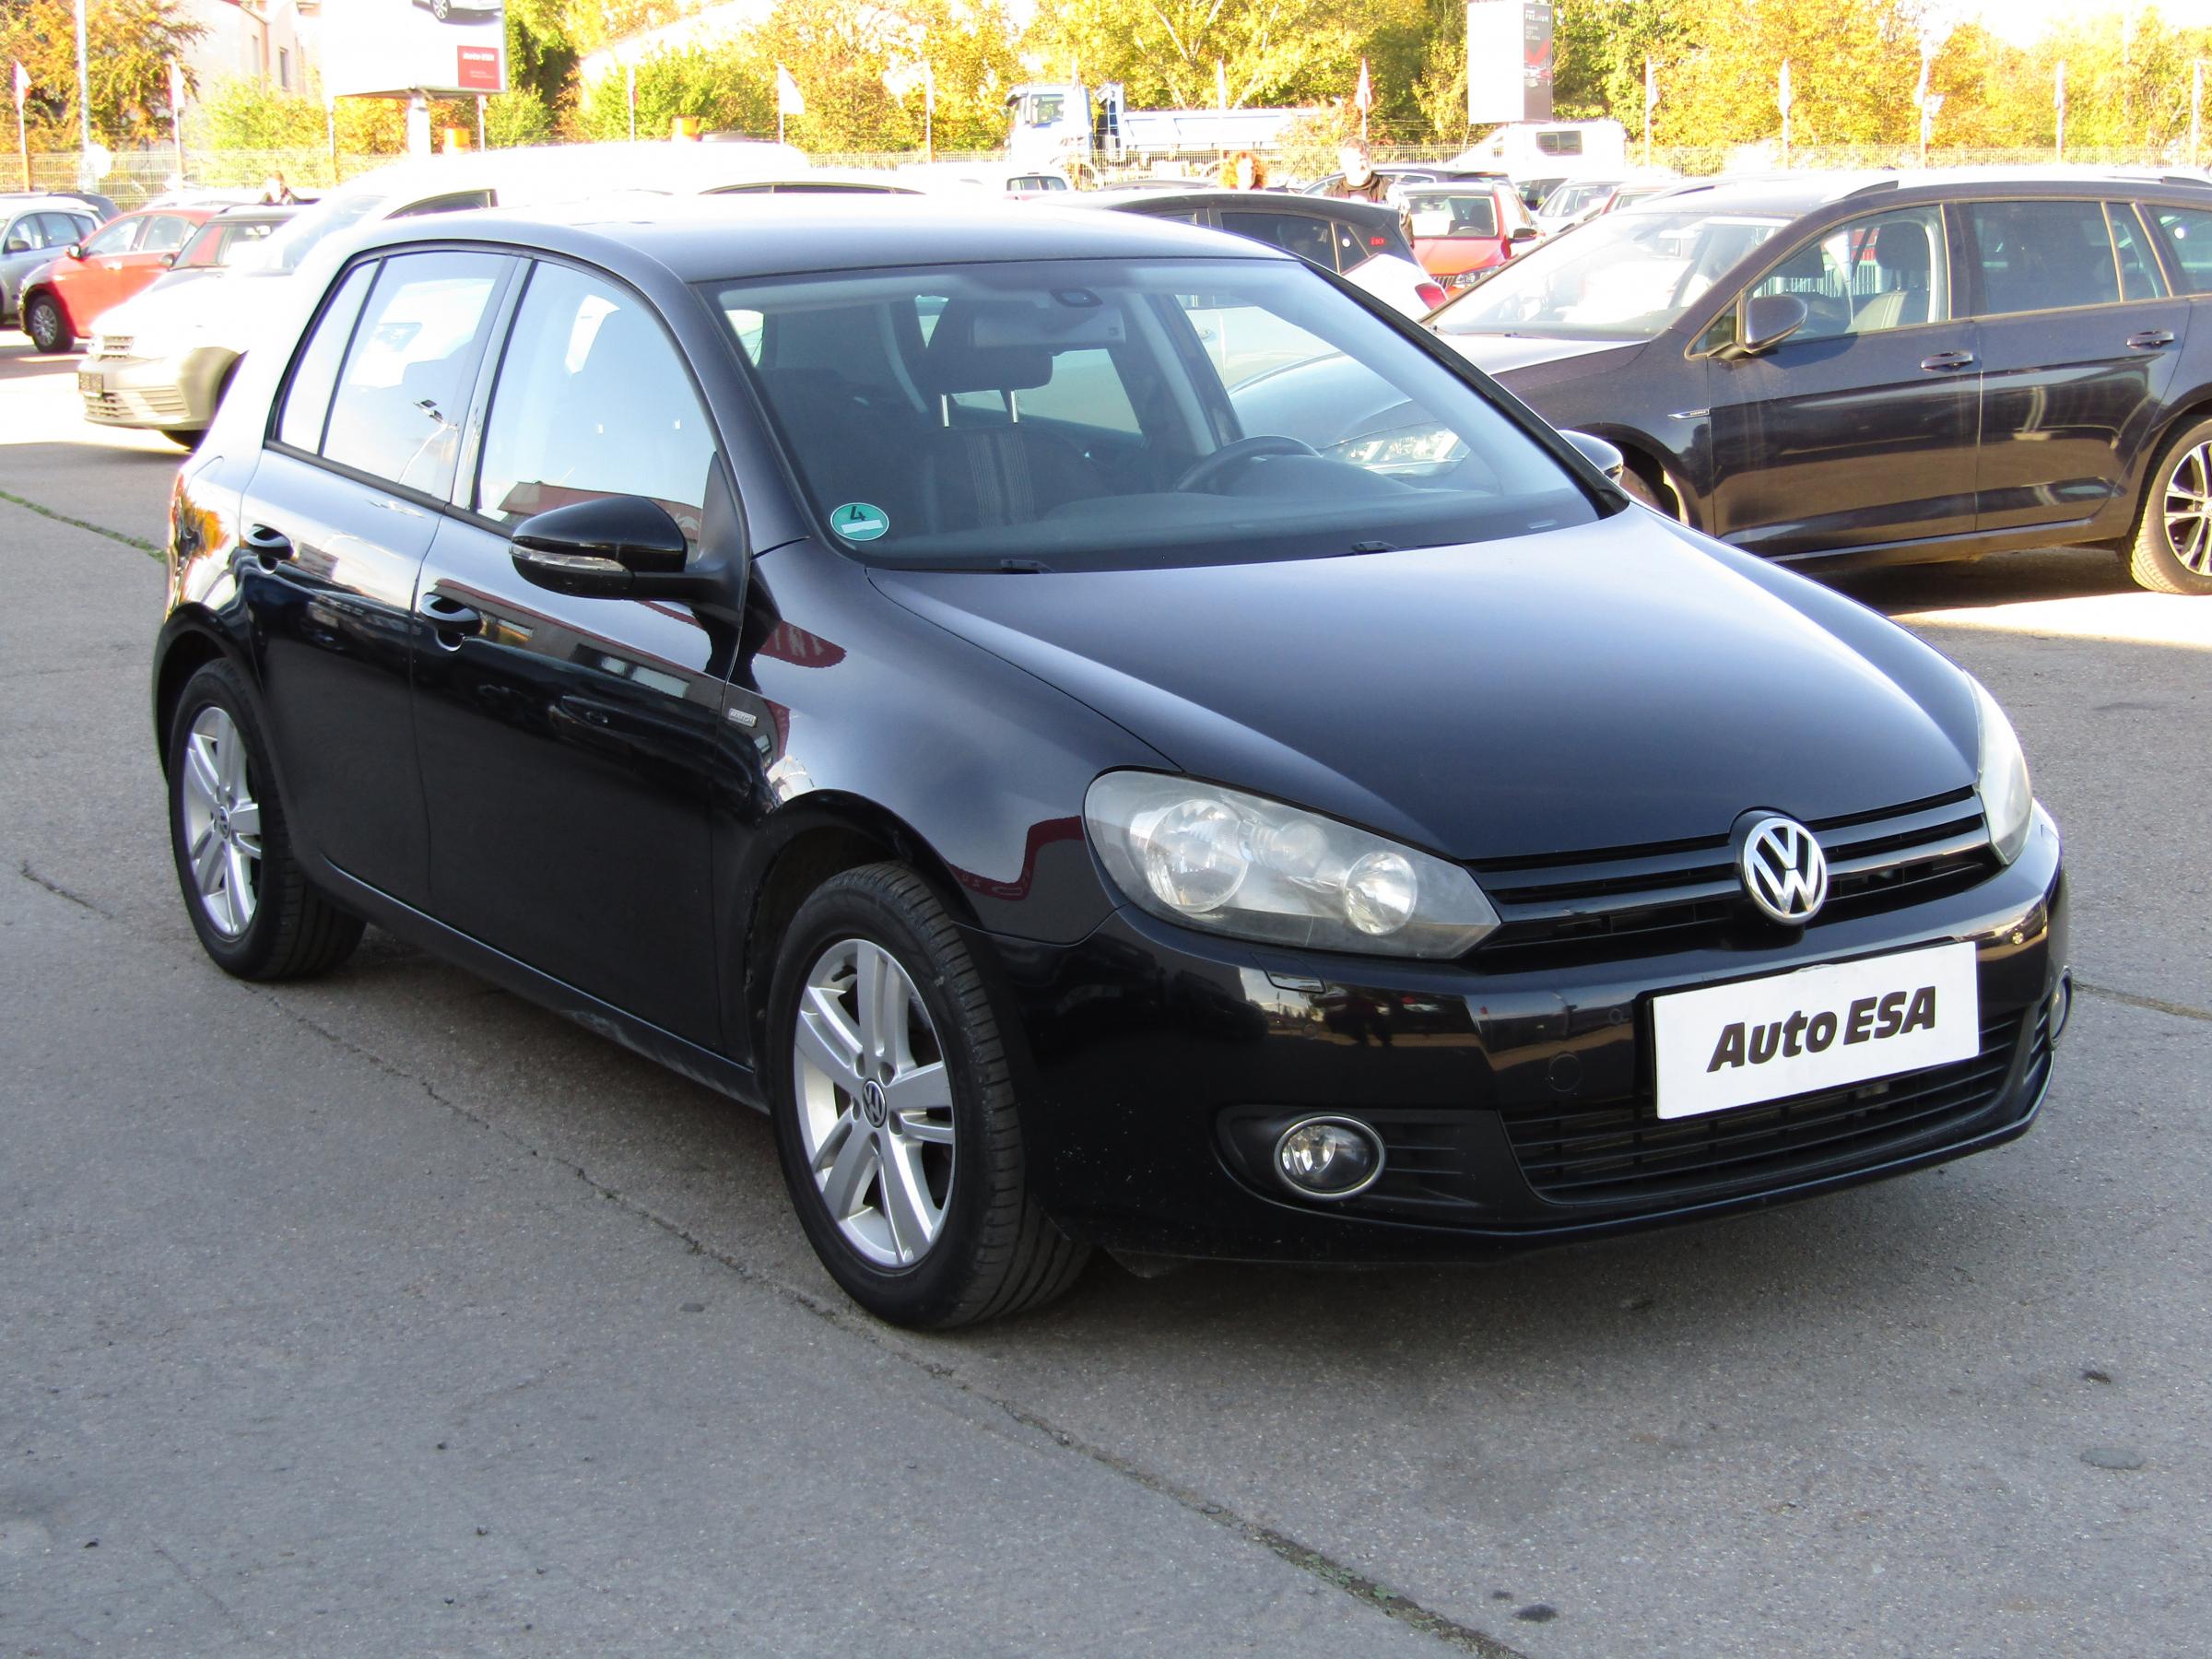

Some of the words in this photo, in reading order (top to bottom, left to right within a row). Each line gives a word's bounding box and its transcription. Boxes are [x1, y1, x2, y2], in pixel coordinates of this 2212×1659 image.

[850, 505, 866, 521] 4
[1705, 1009, 1837, 1073] Auto
[1843, 985, 1936, 1046] ESA
